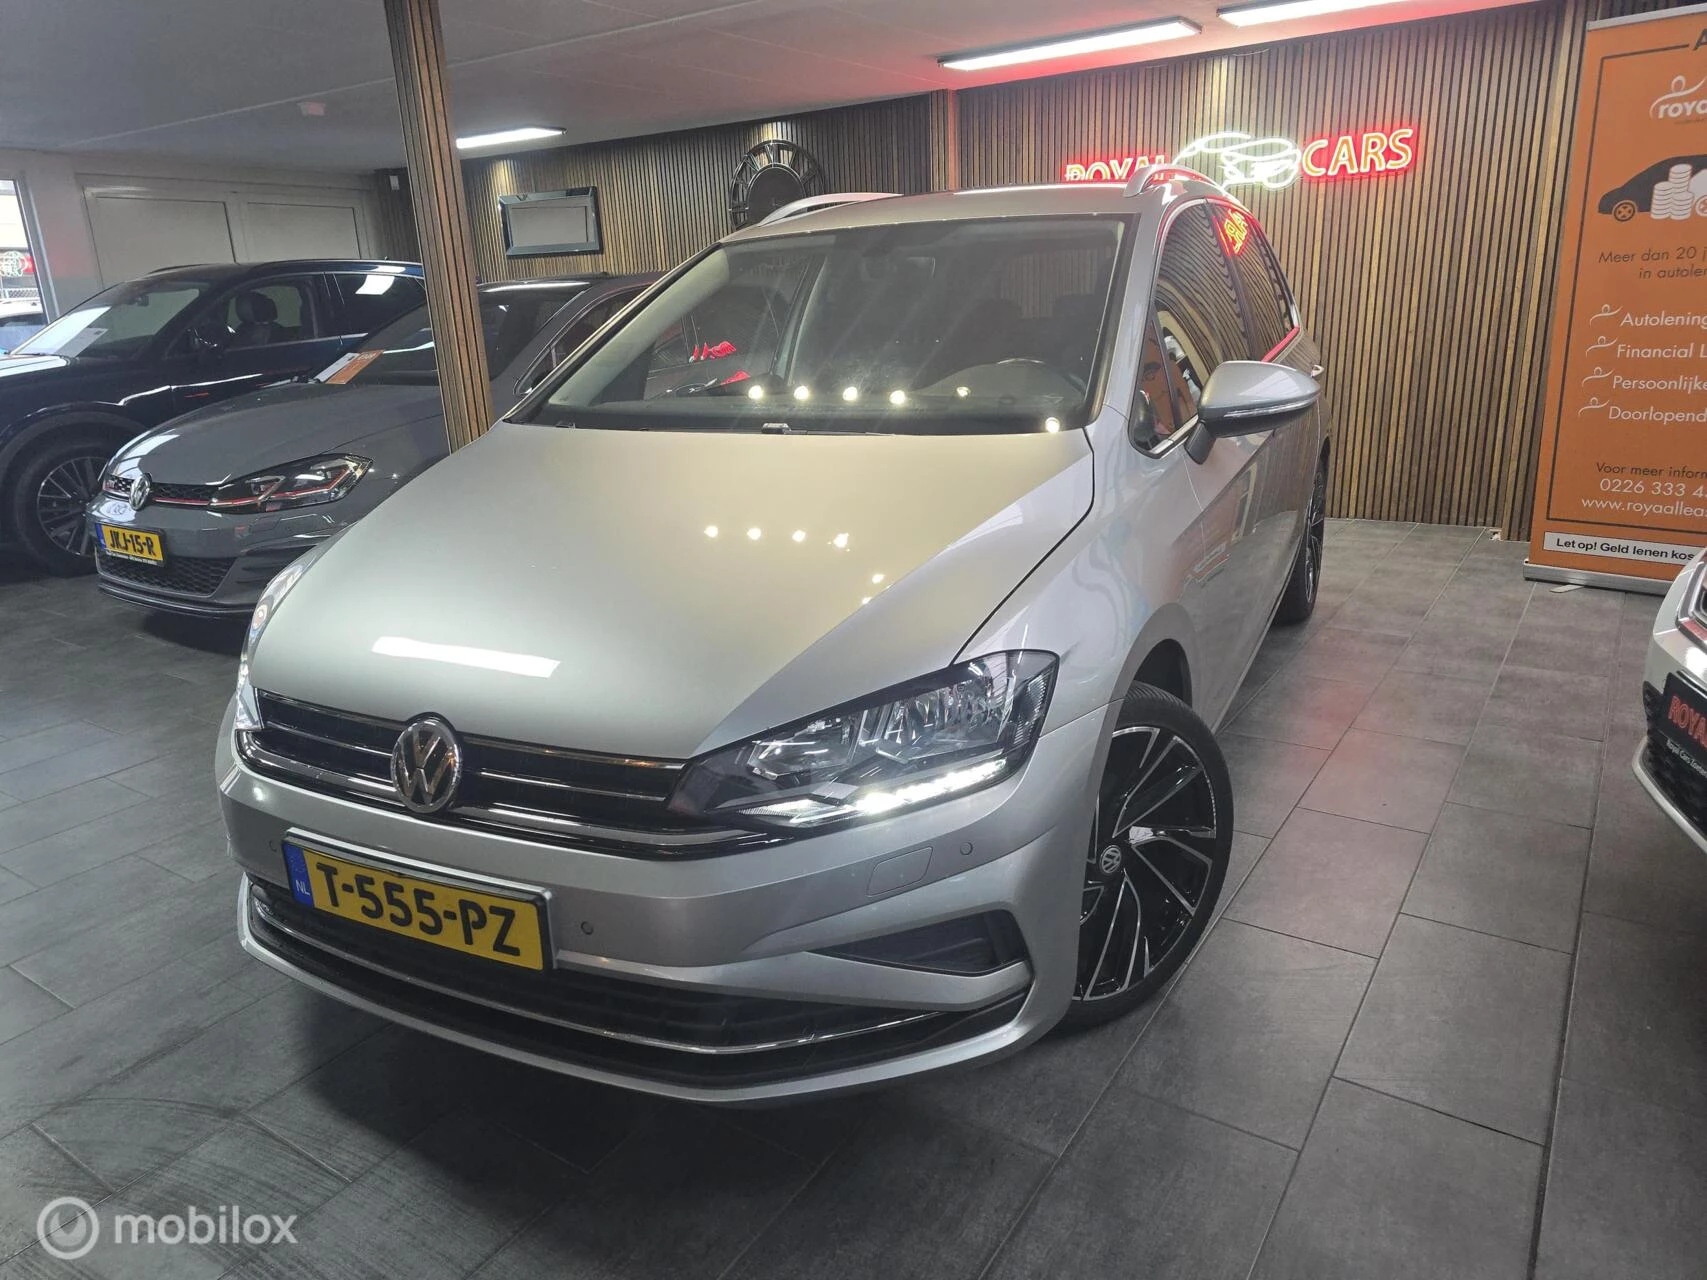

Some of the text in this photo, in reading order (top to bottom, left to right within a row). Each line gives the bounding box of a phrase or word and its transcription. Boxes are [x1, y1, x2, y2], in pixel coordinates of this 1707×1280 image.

[1302, 128, 1413, 177] CARS
[1598, 251, 1635, 263] Meer
[1641, 248, 1669, 262] dan
[1675, 246, 1697, 260] 20
[1638, 267, 1653, 280] in
[1619, 310, 1707, 330] Autolening
[1616, 342, 1695, 359] Financial
[1608, 405, 1707, 425] Doorlopend
[1596, 462, 1626, 474] Voor
[1631, 465, 1664, 477] meer
[1599, 478, 1707, 498] 0226 333 4
[1556, 538, 1576, 549] Let
[1577, 541, 1597, 552] op!
[1600, 542, 1629, 554] Geld
[1632, 546, 1668, 558] lenen
[1667, 694, 1707, 750] ROYA
[295, 879, 311, 896] NL
[315, 861, 521, 957] T-555-PZ
